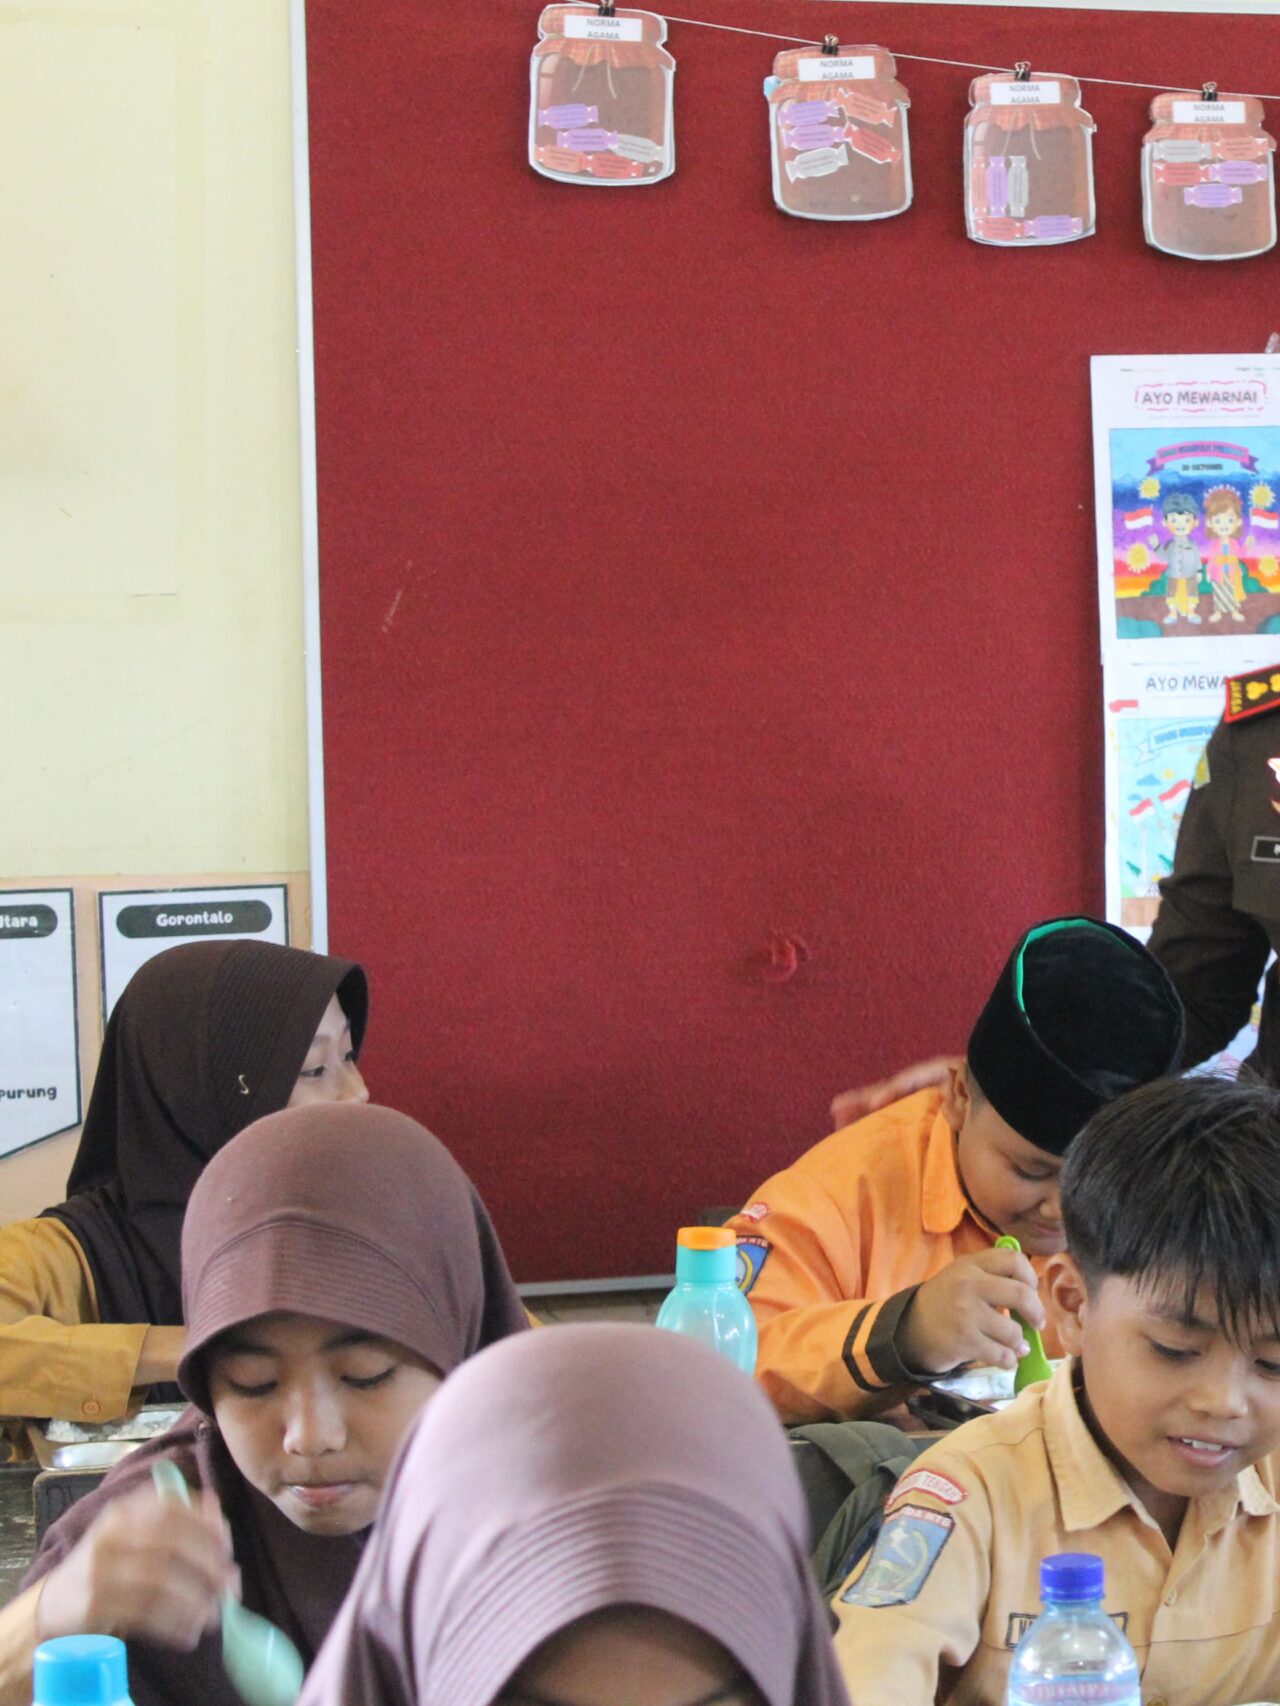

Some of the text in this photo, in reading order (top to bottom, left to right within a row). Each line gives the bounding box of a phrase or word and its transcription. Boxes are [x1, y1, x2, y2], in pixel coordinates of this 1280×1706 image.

[586, 18, 621, 27] NORMA
[586, 31, 620, 39] AGAMA
[820, 59, 853, 68] NORMA
[822, 72, 854, 80] AGAMA
[1009, 84, 1041, 92] NORMA
[1011, 96, 1041, 104] AGAMA
[1193, 103, 1225, 111] NORMA
[1142, 390, 1257, 405] AYO MEWARNAI
[1145, 677, 1178, 691] AYO
[156, 910, 233, 927] Gorontalo
